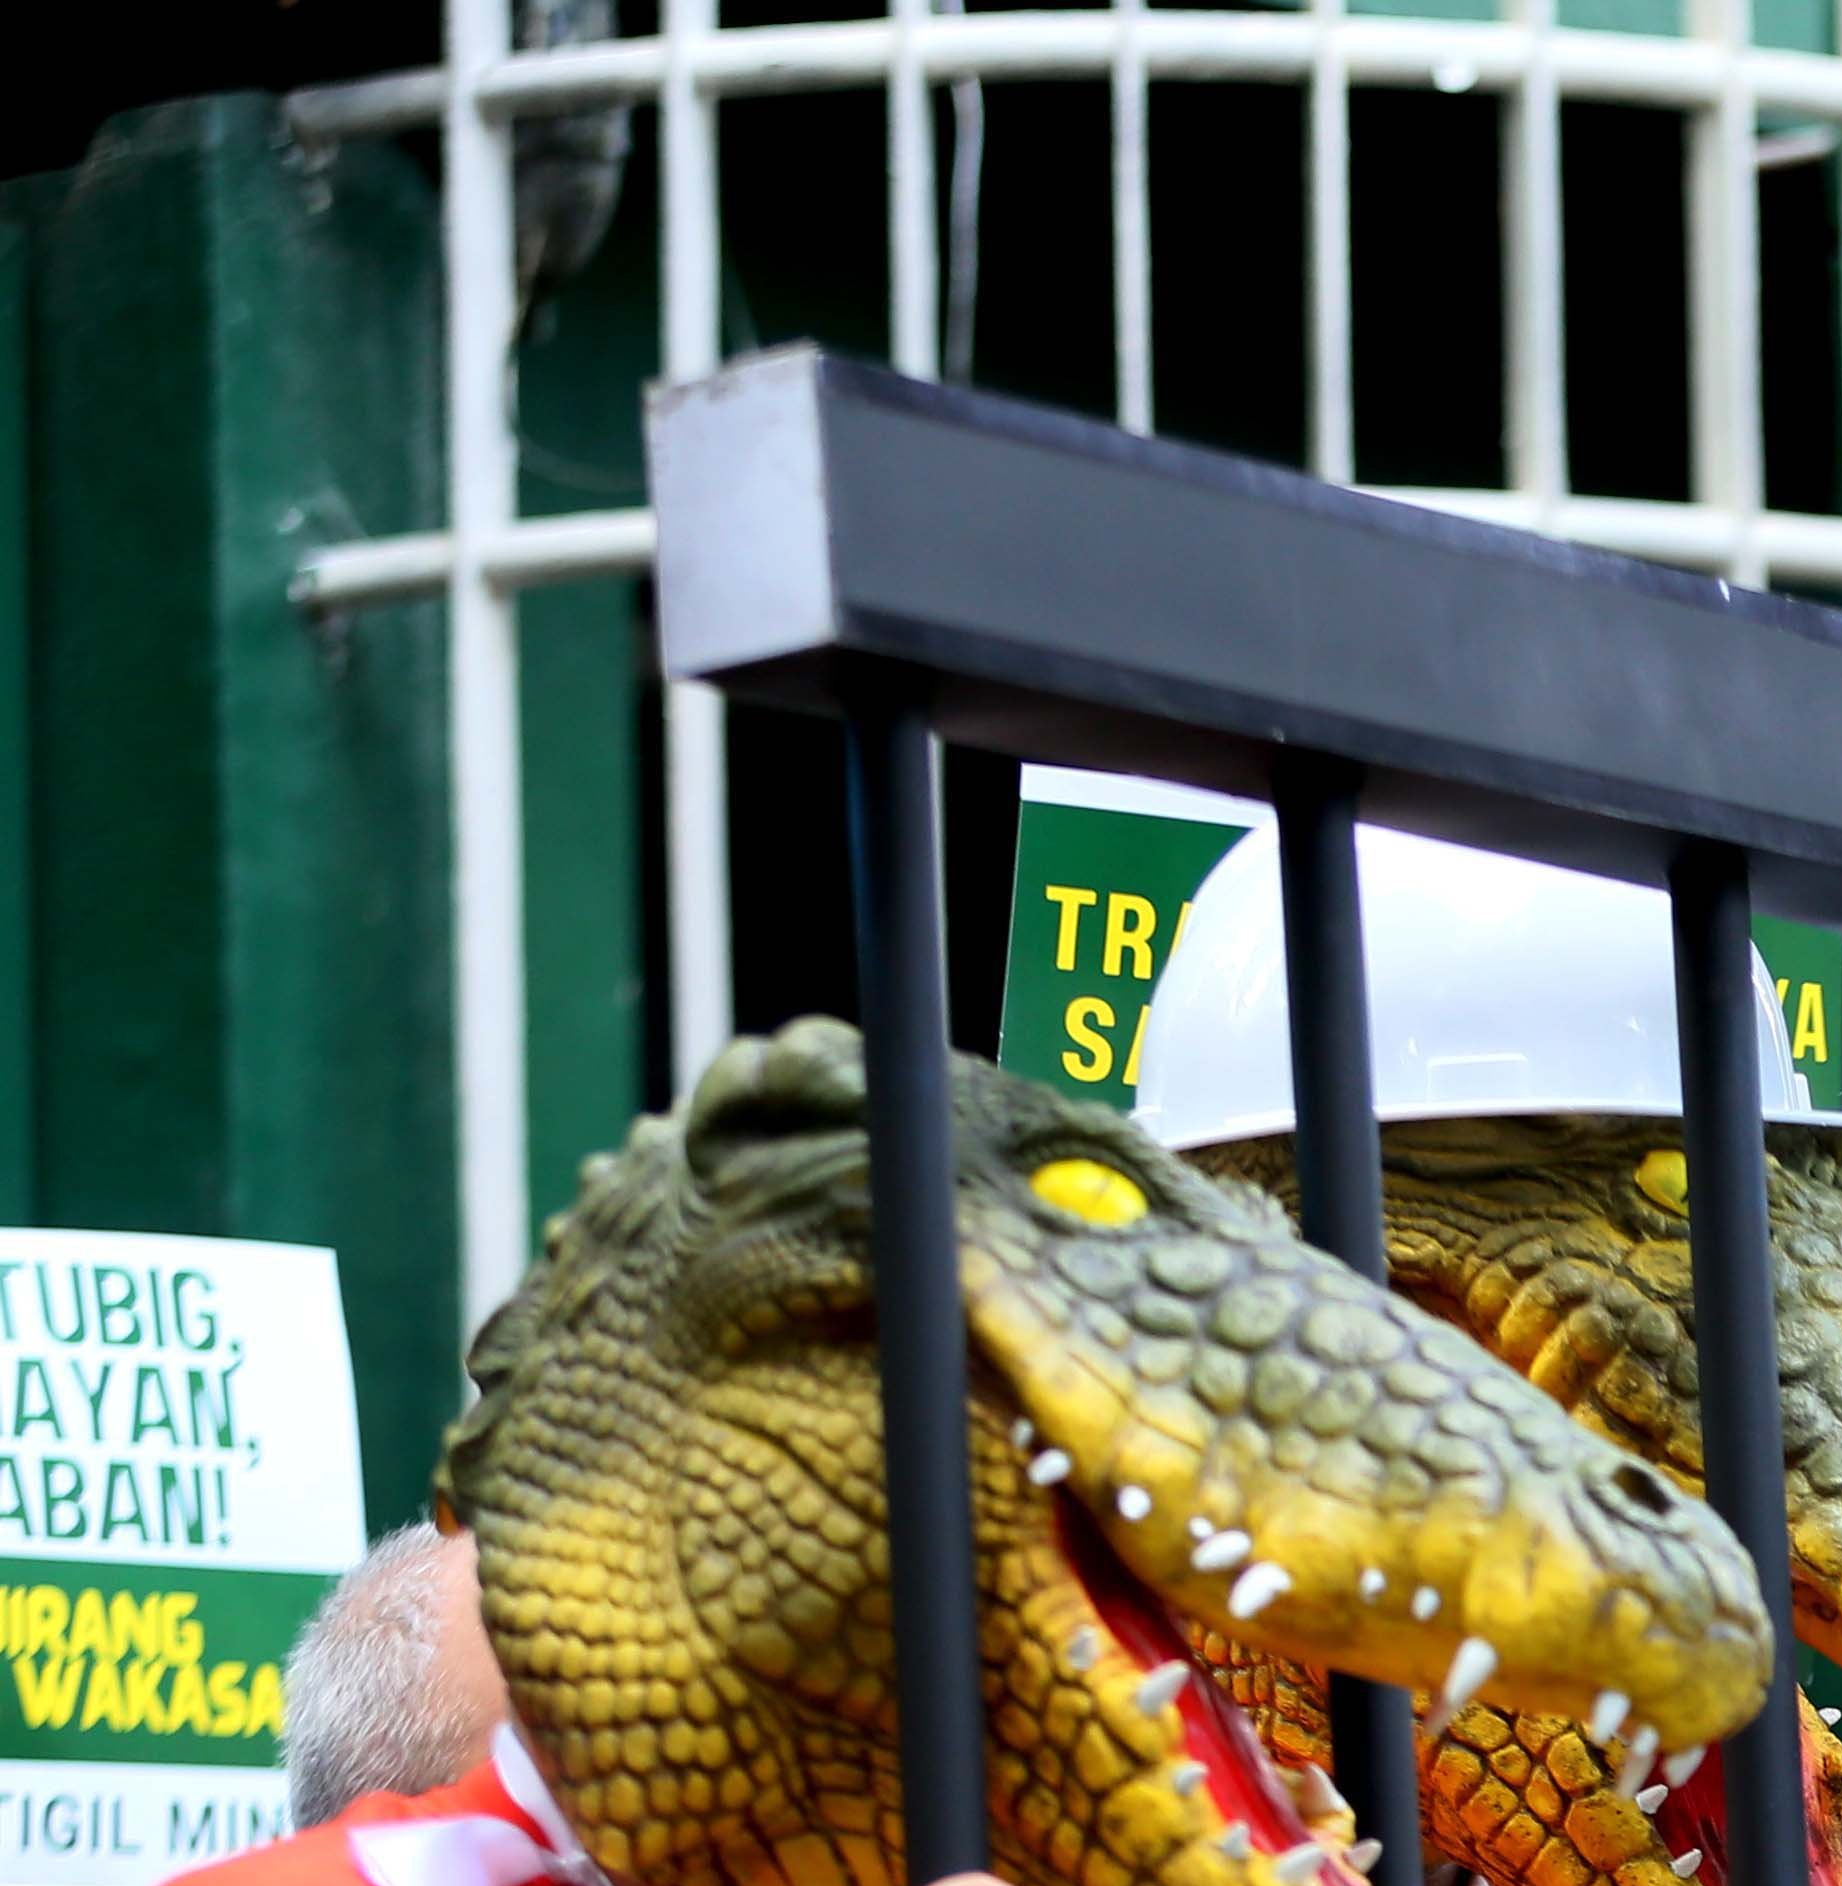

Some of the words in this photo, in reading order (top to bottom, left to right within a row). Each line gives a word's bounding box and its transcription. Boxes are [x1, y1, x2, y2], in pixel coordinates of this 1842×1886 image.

[1045, 884, 1193, 980] TR
[1061, 996, 1150, 1086] S
[0, 1262, 243, 1362] TUBIG,
[0, 1357, 259, 1468] AYAN,
[13, 1655, 284, 1739] WAKASA
[167, 1797, 285, 1855] MIN
